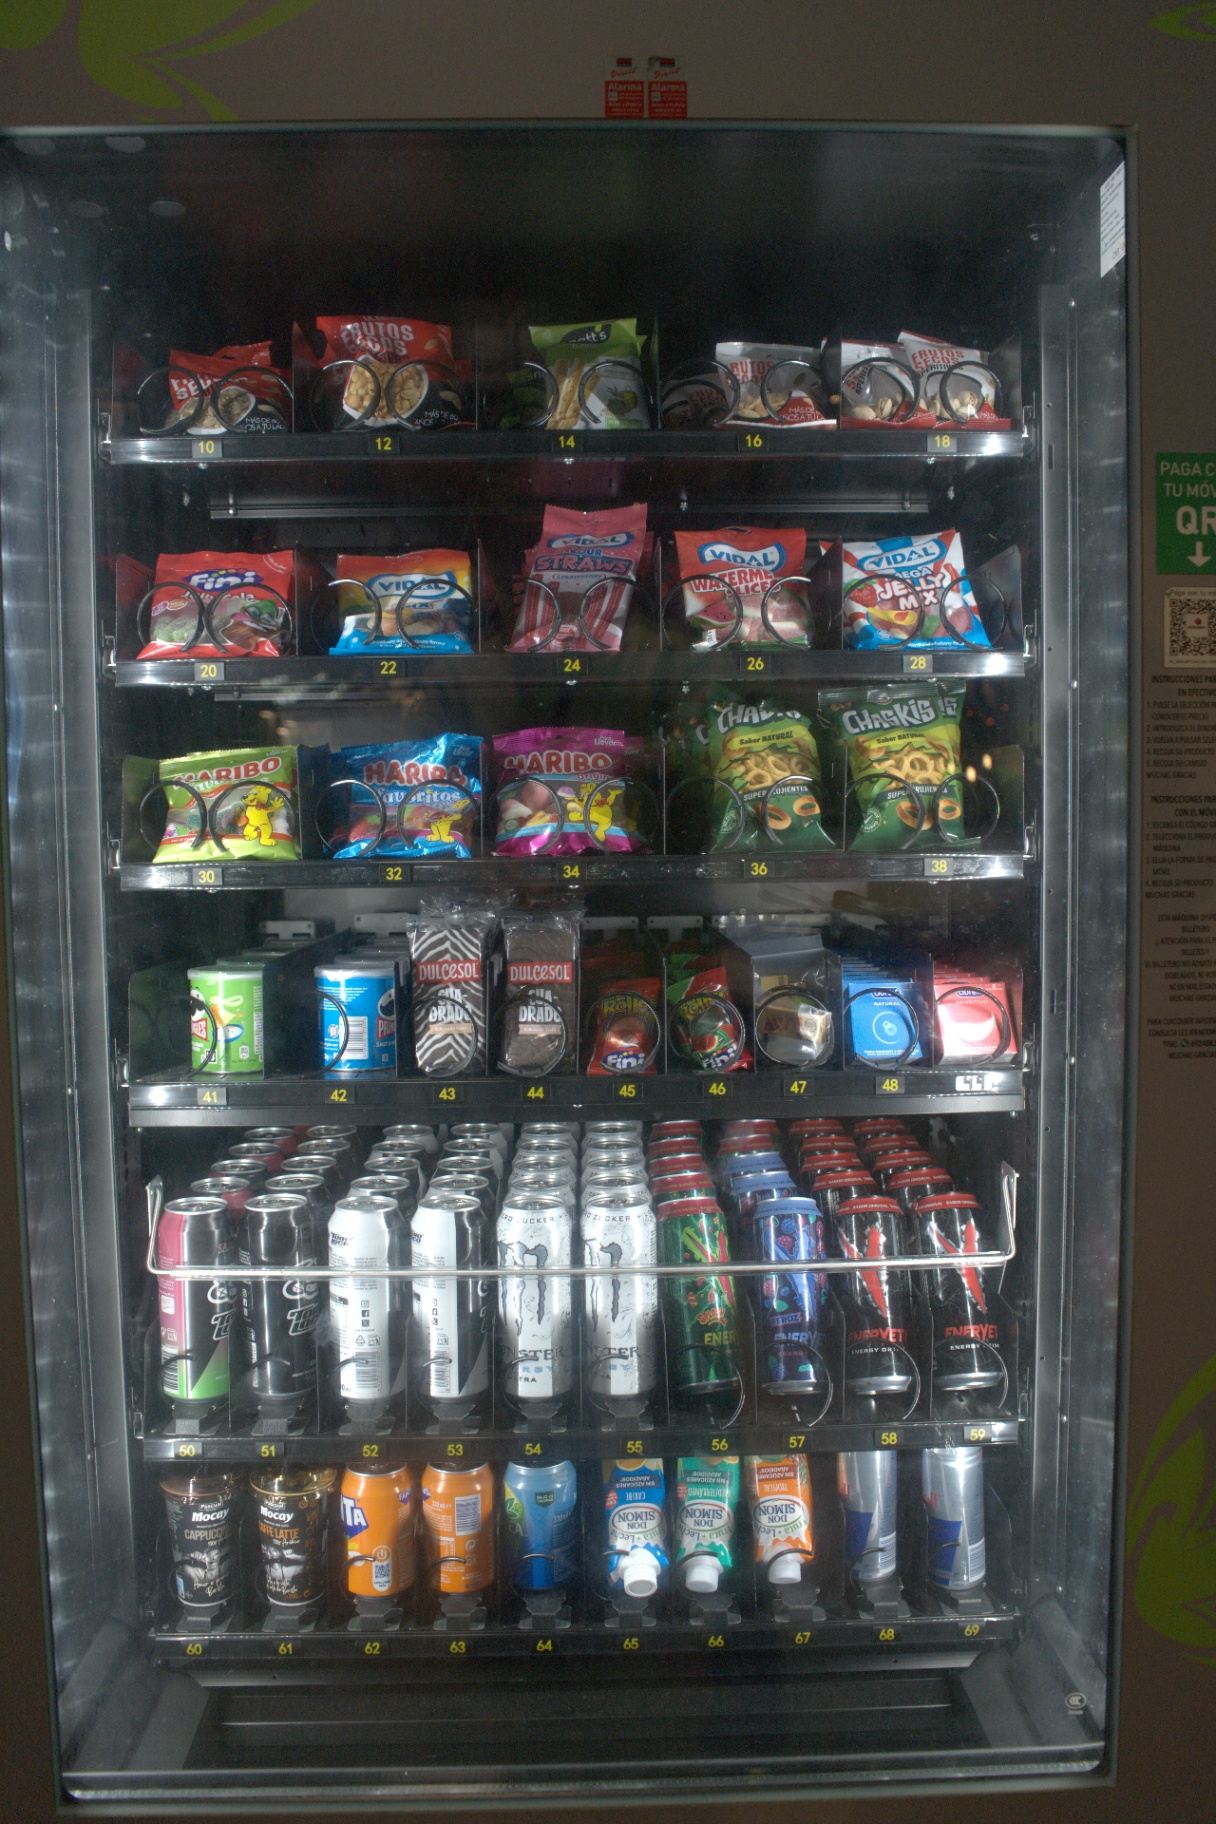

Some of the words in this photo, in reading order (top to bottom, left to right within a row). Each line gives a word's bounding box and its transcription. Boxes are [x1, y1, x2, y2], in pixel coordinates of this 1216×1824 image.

[608, 84, 643, 92] Alarma
[340, 322, 414, 349] FRUTOS
[912, 350, 964, 364] FRUTOS
[914, 356, 960, 371] SECOS
[198, 439, 215, 454] 10
[375, 436, 392, 451] 12
[559, 435, 576, 448] 14
[745, 434, 763, 448] 16
[935, 434, 951, 449] 18
[1160, 462, 1202, 476] PAGA
[1163, 482, 1183, 497] TU
[1176, 506, 1216, 536] QR
[562, 535, 620, 546] VIDAL
[568, 548, 602, 557] SOUR
[709, 549, 774, 568] VIDAL
[869, 547, 935, 568] VIDAL
[536, 554, 629, 573] STRAWS
[894, 567, 934, 579] MEGA
[190, 570, 256, 591] Fini
[378, 580, 446, 592] VIDAL
[879, 574, 945, 600] JELLY
[380, 660, 397, 675] 22
[563, 658, 581, 673] 24
[747, 657, 765, 671] 26
[910, 655, 927, 670] 28
[200, 664, 218, 679] 20
[1178, 688, 1186, 696] EN
[842, 699, 938, 735] CHASKIS
[739, 736, 761, 746] Sabor
[762, 731, 794, 742] NATURAL
[876, 736, 896, 744] Sabor
[898, 733, 926, 742] NATURAL
[504, 750, 612, 774] HARIBO
[174, 758, 282, 788] HARIBO
[364, 760, 467, 786] HARIBO
[744, 790, 766, 801] SUPER
[563, 865, 580, 879] 34
[751, 861, 769, 876] 36
[931, 859, 948, 873] 38
[198, 869, 216, 884] 30
[386, 866, 402, 881] 32
[419, 962, 479, 981] DULCESOL
[510, 966, 570, 982] DULCESOL
[606, 1052, 646, 1069] Fini
[703, 1046, 738, 1069] Fini
[619, 1084, 637, 1098] 45
[708, 1082, 727, 1096] 46
[790, 1080, 807, 1094] 47
[882, 1078, 899, 1092] 48
[202, 1091, 217, 1103] 41
[330, 1089, 347, 1103] 42
[438, 1087, 456, 1101] 43
[527, 1086, 545, 1099] 44
[771, 1313, 799, 1324] FEROZ
[852, 1346, 879, 1354] ENERGY
[788, 1435, 806, 1449] 57
[881, 1432, 898, 1445] 58
[969, 1428, 986, 1442] 59
[179, 1445, 196, 1458] 50
[261, 1444, 276, 1458] 51
[361, 1444, 379, 1458] 52
[446, 1443, 464, 1457] 53
[525, 1442, 542, 1455] 54
[626, 1440, 643, 1453] 55
[711, 1438, 729, 1451] 56
[764, 1483, 788, 1492] TROPICAL
[626, 1492, 646, 1500] CARIBE
[192, 1508, 230, 1522] Mocay
[260, 1505, 294, 1524] Mocay
[618, 1511, 656, 1522] SIMON
[686, 1508, 722, 1519] SIMON
[758, 1504, 796, 1516] SIMON
[627, 1522, 646, 1530] DON
[694, 1520, 714, 1528] DON
[768, 1514, 788, 1524] DON
[274, 1528, 300, 1540] LATTE
[879, 1628, 895, 1641] 68
[963, 1623, 981, 1637] 69
[622, 1637, 640, 1651] 65
[707, 1635, 725, 1648] 66
[794, 1631, 812, 1645] 67
[185, 1642, 203, 1656] 60
[278, 1642, 293, 1655] 61
[363, 1641, 381, 1655] 62
[449, 1640, 466, 1654] 63
[536, 1639, 553, 1652] 64
